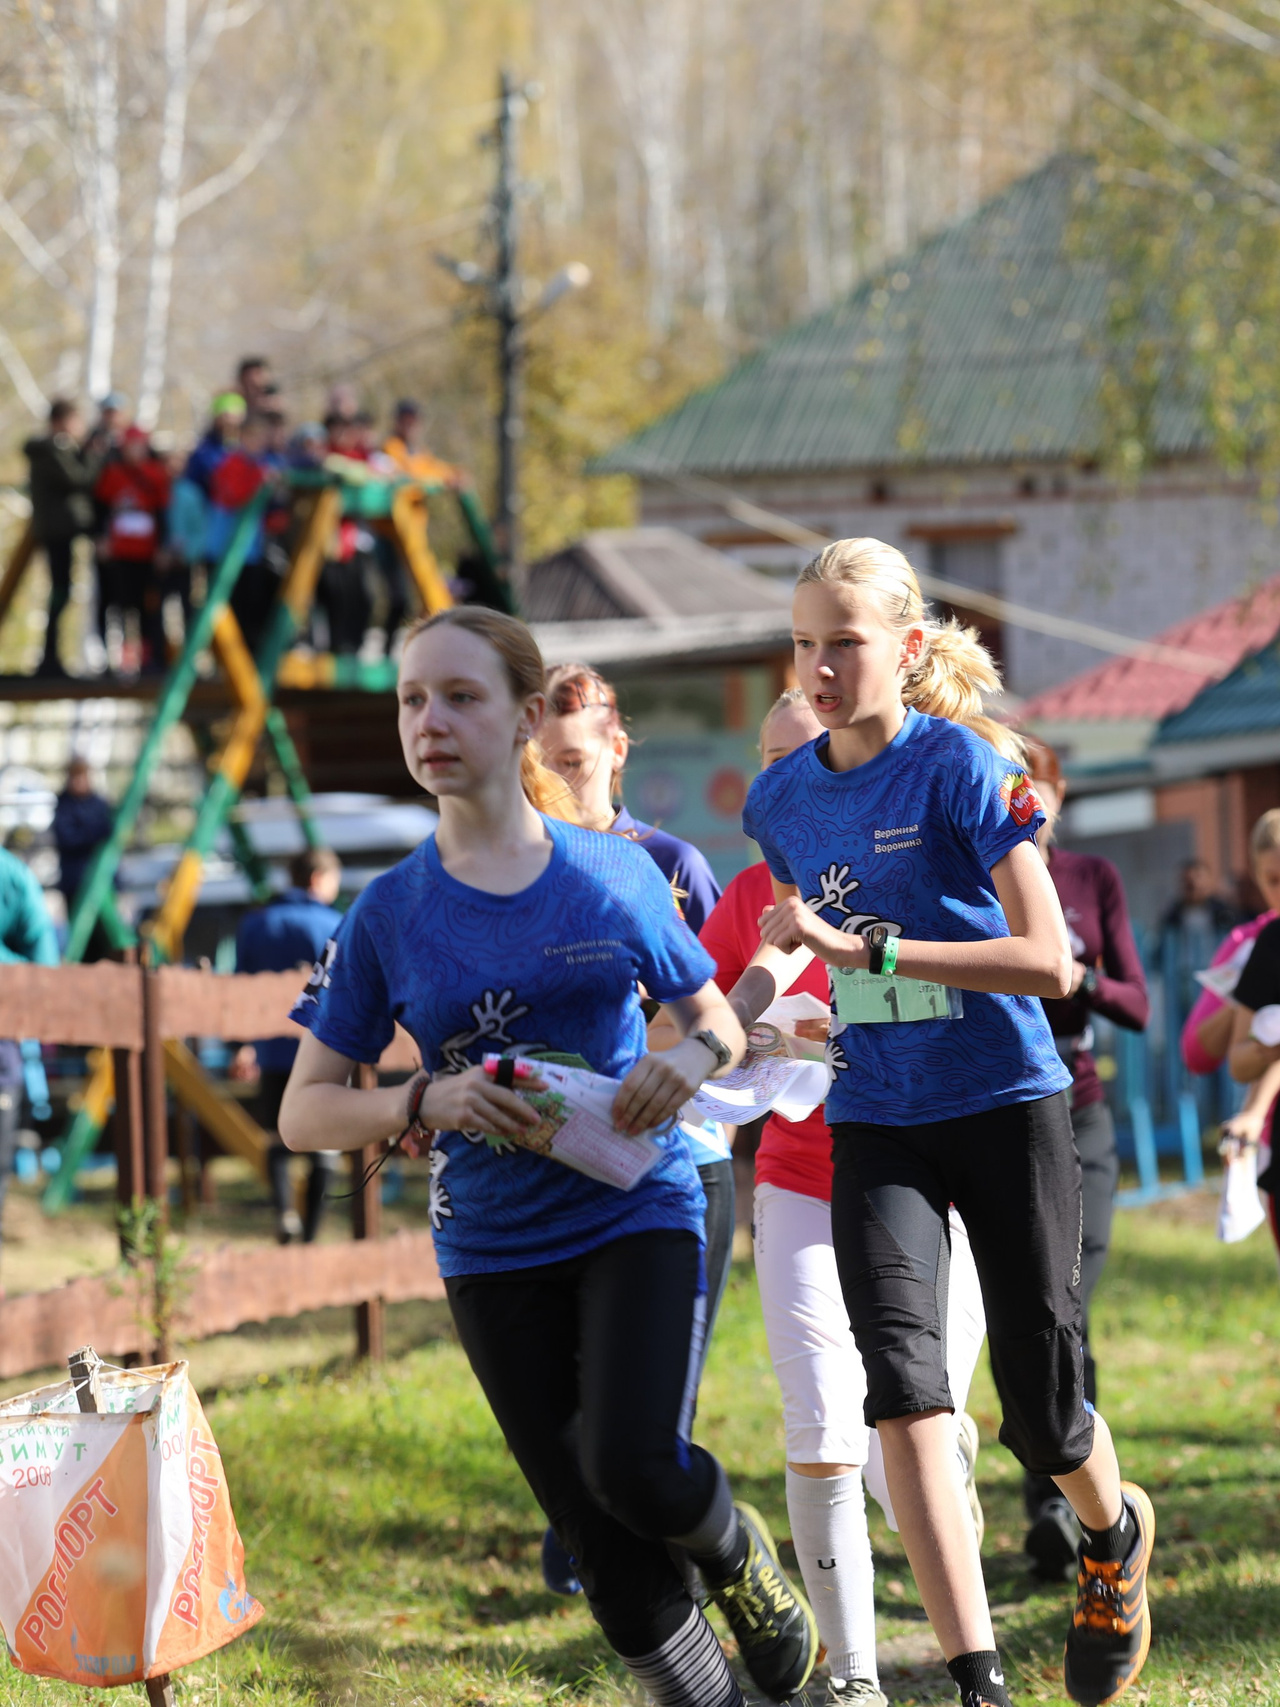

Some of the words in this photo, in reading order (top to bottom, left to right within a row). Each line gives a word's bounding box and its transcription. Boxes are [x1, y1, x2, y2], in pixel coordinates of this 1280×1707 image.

[873, 823, 919, 840] Вероника
[874, 837, 923, 854] Воронина
[883, 986, 900, 1022] 1
[928, 994, 938, 1018] 1
